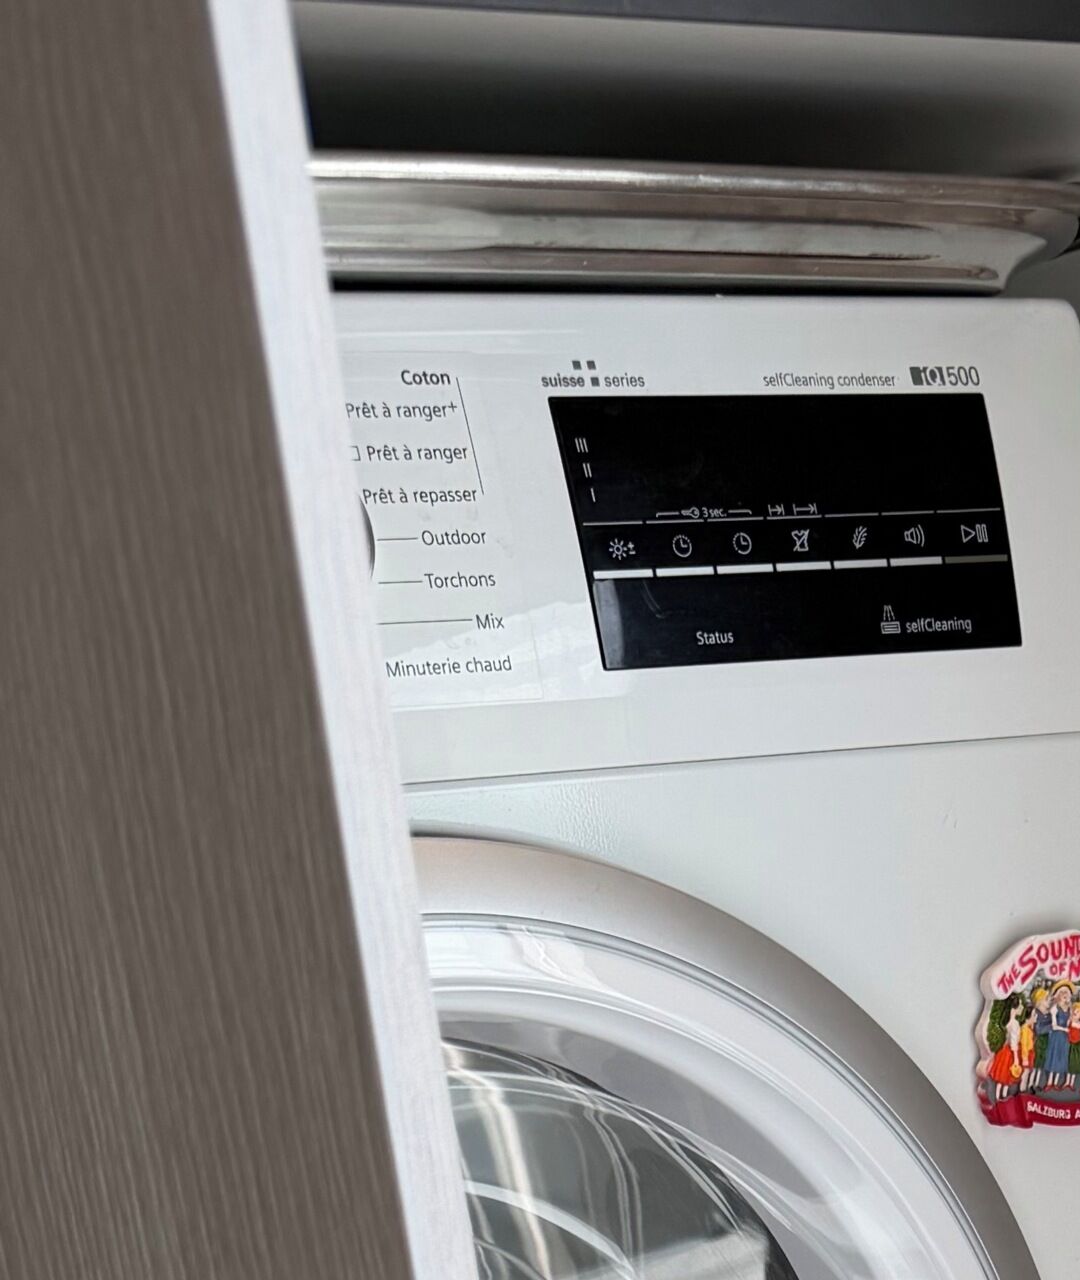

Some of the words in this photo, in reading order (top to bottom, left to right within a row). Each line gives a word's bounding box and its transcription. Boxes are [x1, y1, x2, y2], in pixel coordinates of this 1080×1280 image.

[401, 369, 451, 386] Coton
[541, 372, 586, 388] suisse
[604, 372, 646, 388] series
[763, 371, 835, 390] selfCleaning
[837, 372, 896, 387] condenser
[345, 401, 378, 419] Prêt
[382, 401, 392, 419] à
[366, 444, 399, 461] Prêt
[403, 444, 413, 461] à
[417, 447, 468, 464] ranger
[362, 487, 394, 505] Prêt
[399, 487, 409, 504] à
[413, 488, 478, 507] repasser
[421, 529, 487, 546] Outdoor
[424, 571, 496, 589] Torchons
[475, 612, 505, 630] Mix
[905, 616, 972, 633] selfCleaning
[696, 630, 734, 645] Status
[385, 657, 461, 678] Minuterie
[465, 655, 513, 674] chaud
[1049, 961, 1067, 976] OF
[997, 963, 1021, 994] THE
[1026, 1101, 1071, 1120] SALZBURG
